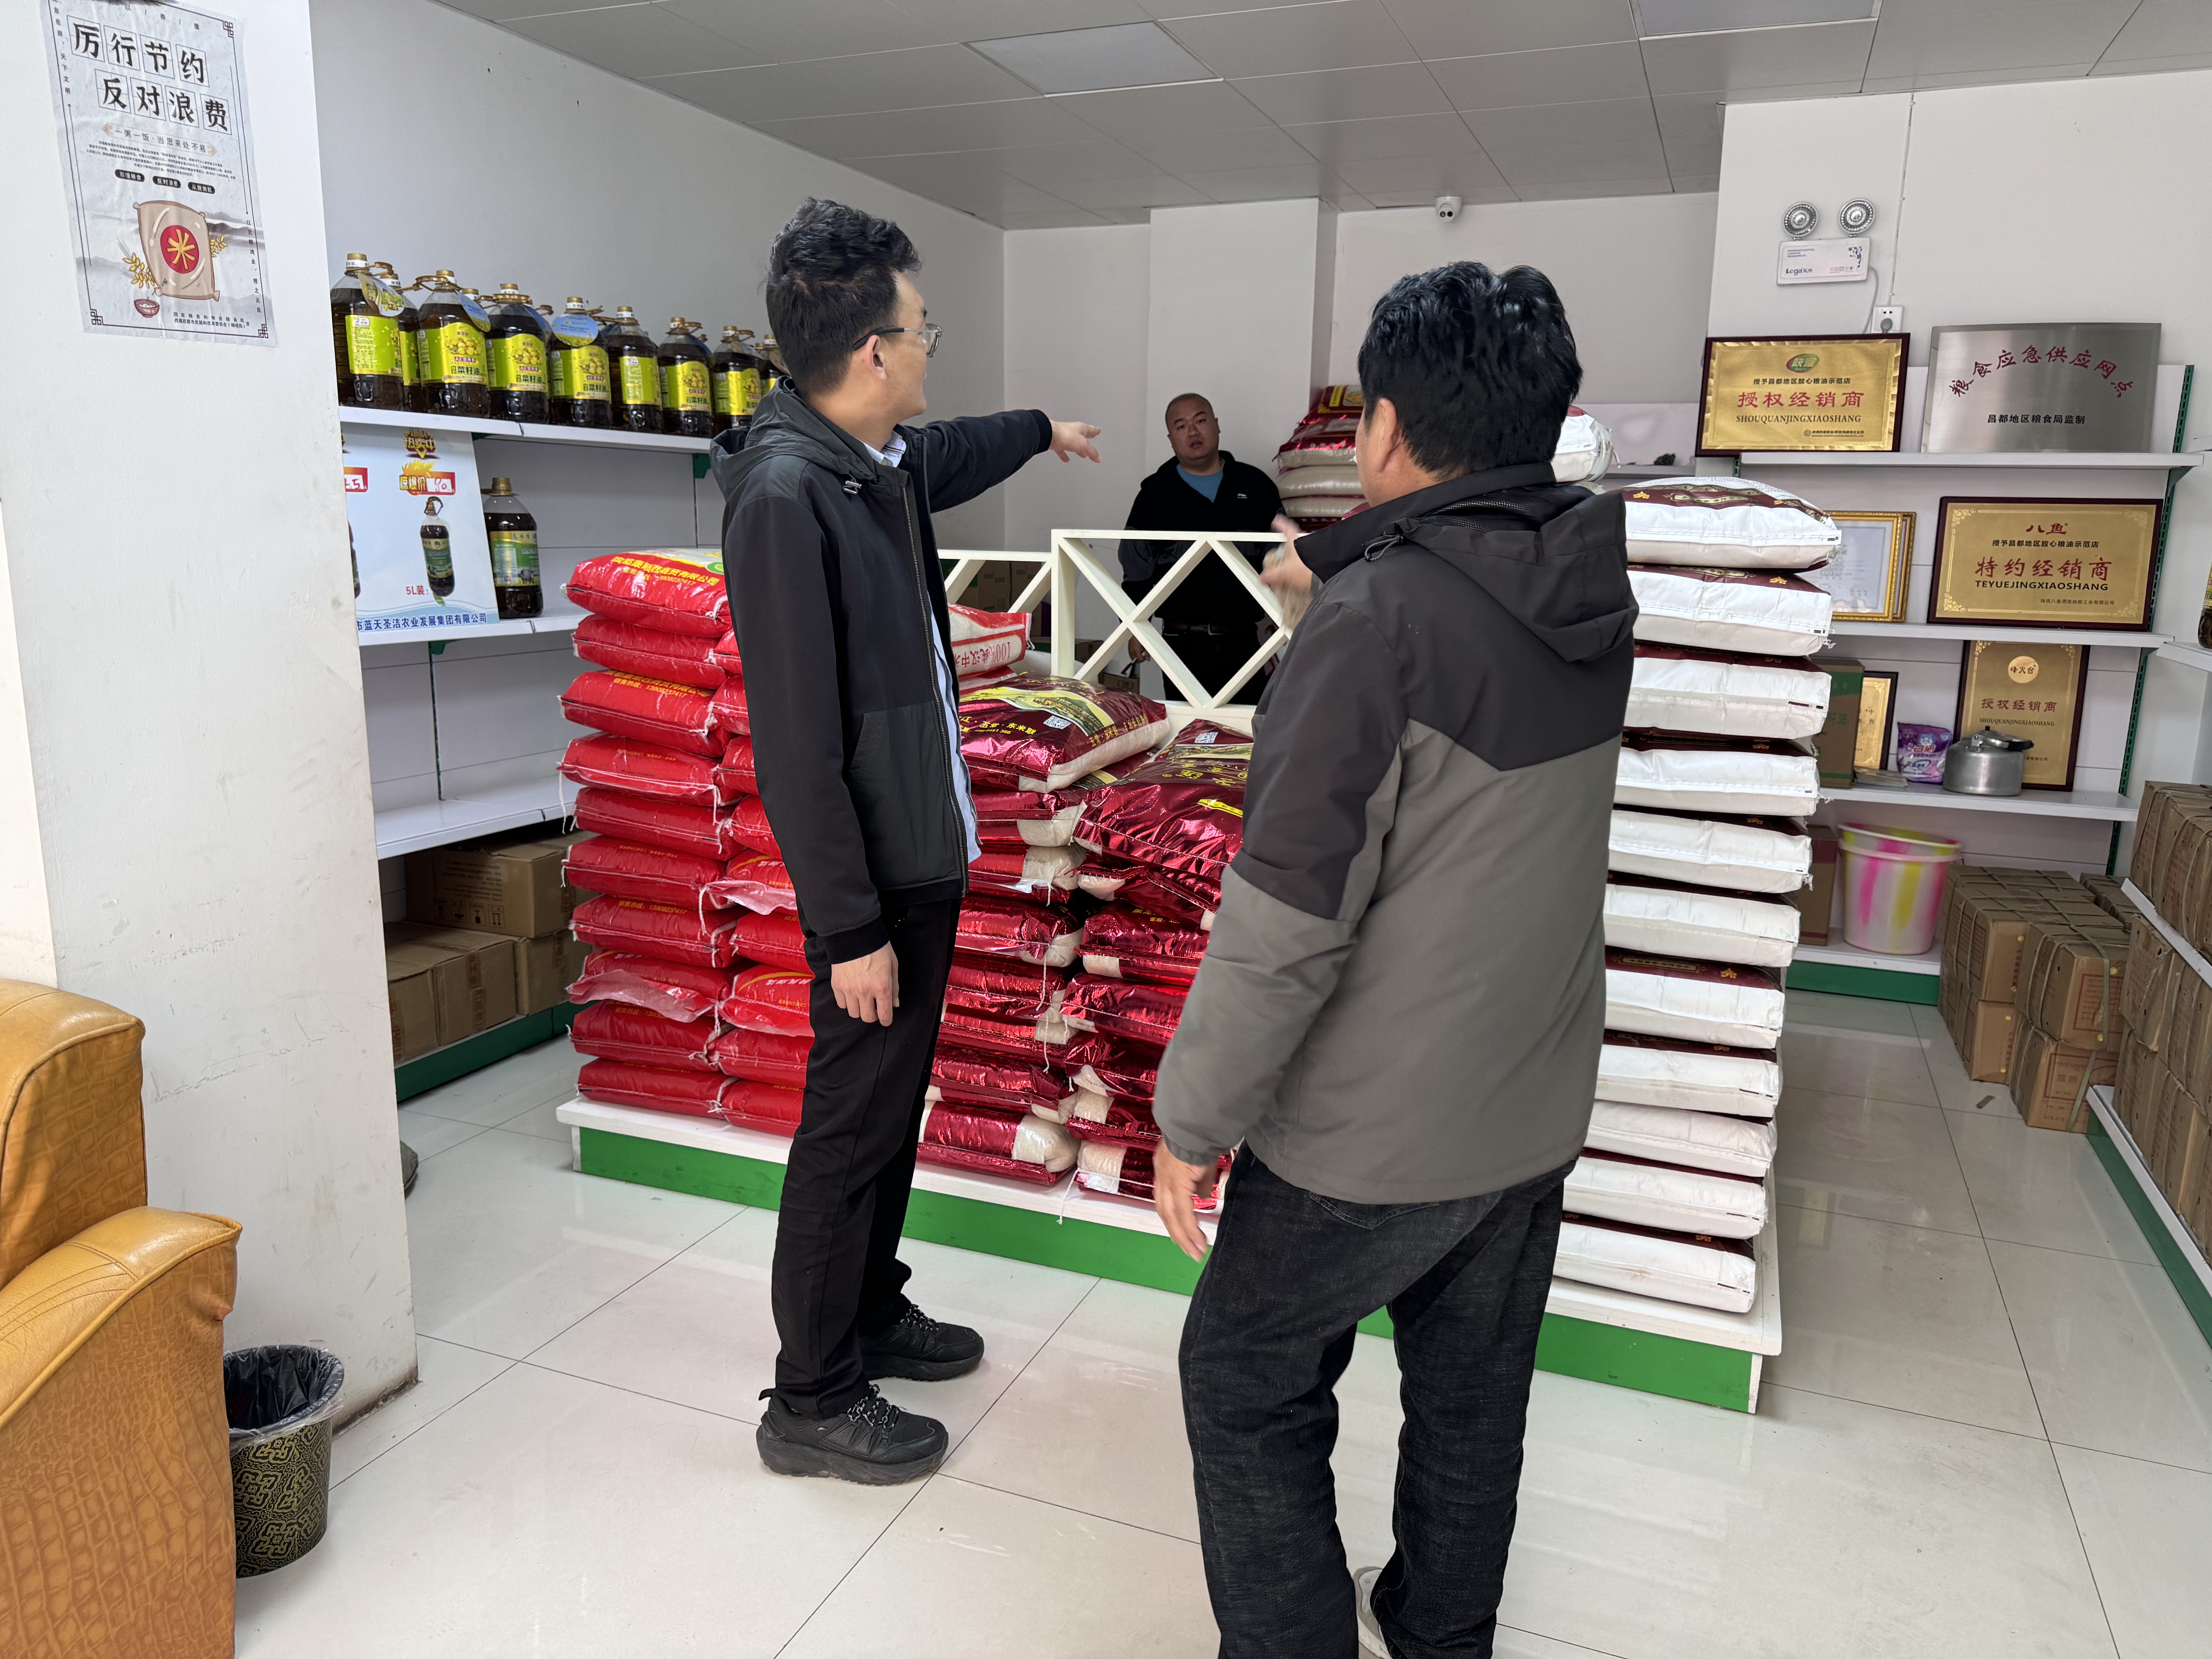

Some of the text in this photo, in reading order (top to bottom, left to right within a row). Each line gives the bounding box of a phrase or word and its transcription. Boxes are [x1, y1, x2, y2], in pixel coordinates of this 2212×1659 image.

[73, 22, 204, 84] 厉行节约
[103, 78, 228, 132] 反对浪费
[1949, 344, 2134, 398] 粮食应急供应网点
[1737, 391, 1864, 408] 授权经销商
[1736, 415, 1861, 424] SHOUQUANJINGXIAOSHANG
[1987, 414, 2085, 424] 昌都地区粮食局监制
[399, 475, 426, 491] 惊爆价
[2026, 523, 2067, 536] 八鱼
[1992, 539, 2099, 548] 授予昌都地区放心粮油示范店
[1975, 555, 2112, 582] 特约经销商
[1975, 580, 2109, 591] TEYUEJINGXIAOSHANG
[1982, 698, 2057, 713] 授权经销商
[1980, 718, 2055, 726] SHOUQUANJINGXIAOSHANG
